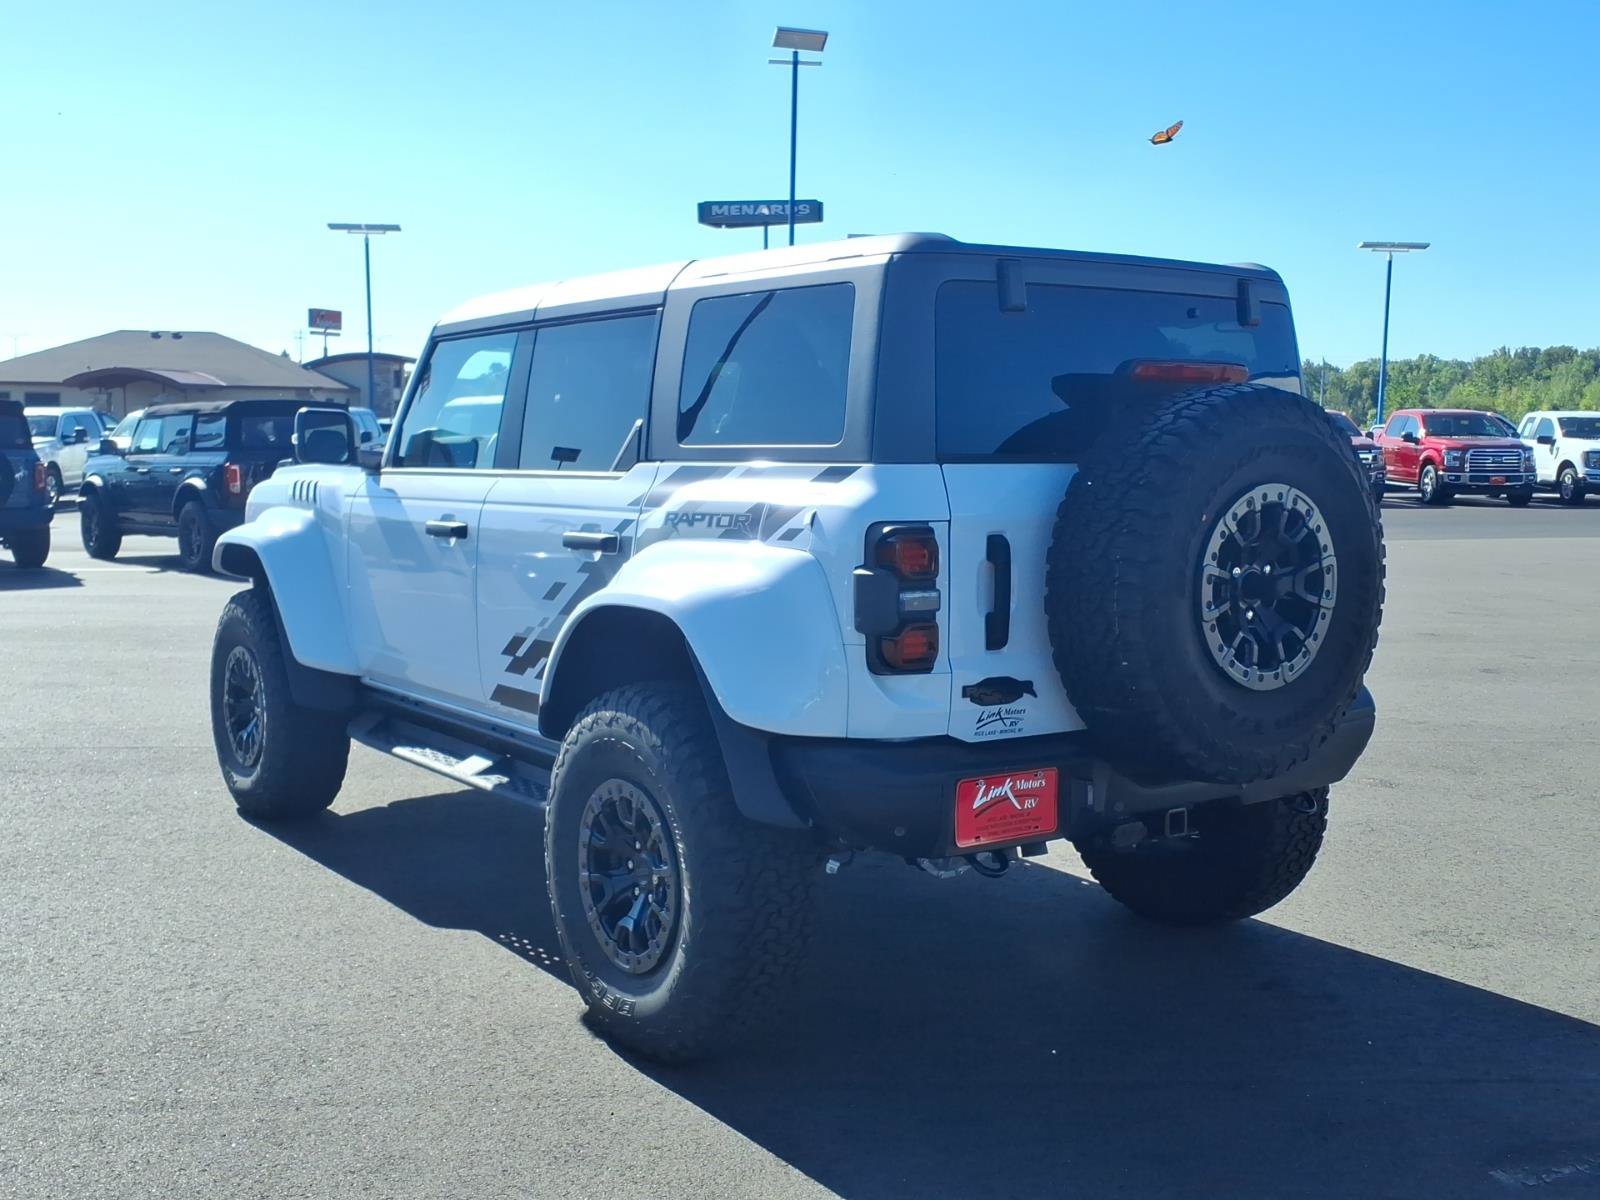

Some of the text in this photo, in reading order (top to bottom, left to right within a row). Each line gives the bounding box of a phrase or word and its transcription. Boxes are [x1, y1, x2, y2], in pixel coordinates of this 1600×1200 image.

[711, 204, 811, 216] MENARDS
[664, 511, 753, 537] RAPTOR
[975, 707, 1026, 727] Link Motors
[972, 777, 1046, 810] Link Motors
[1024, 797, 1039, 810] RV
